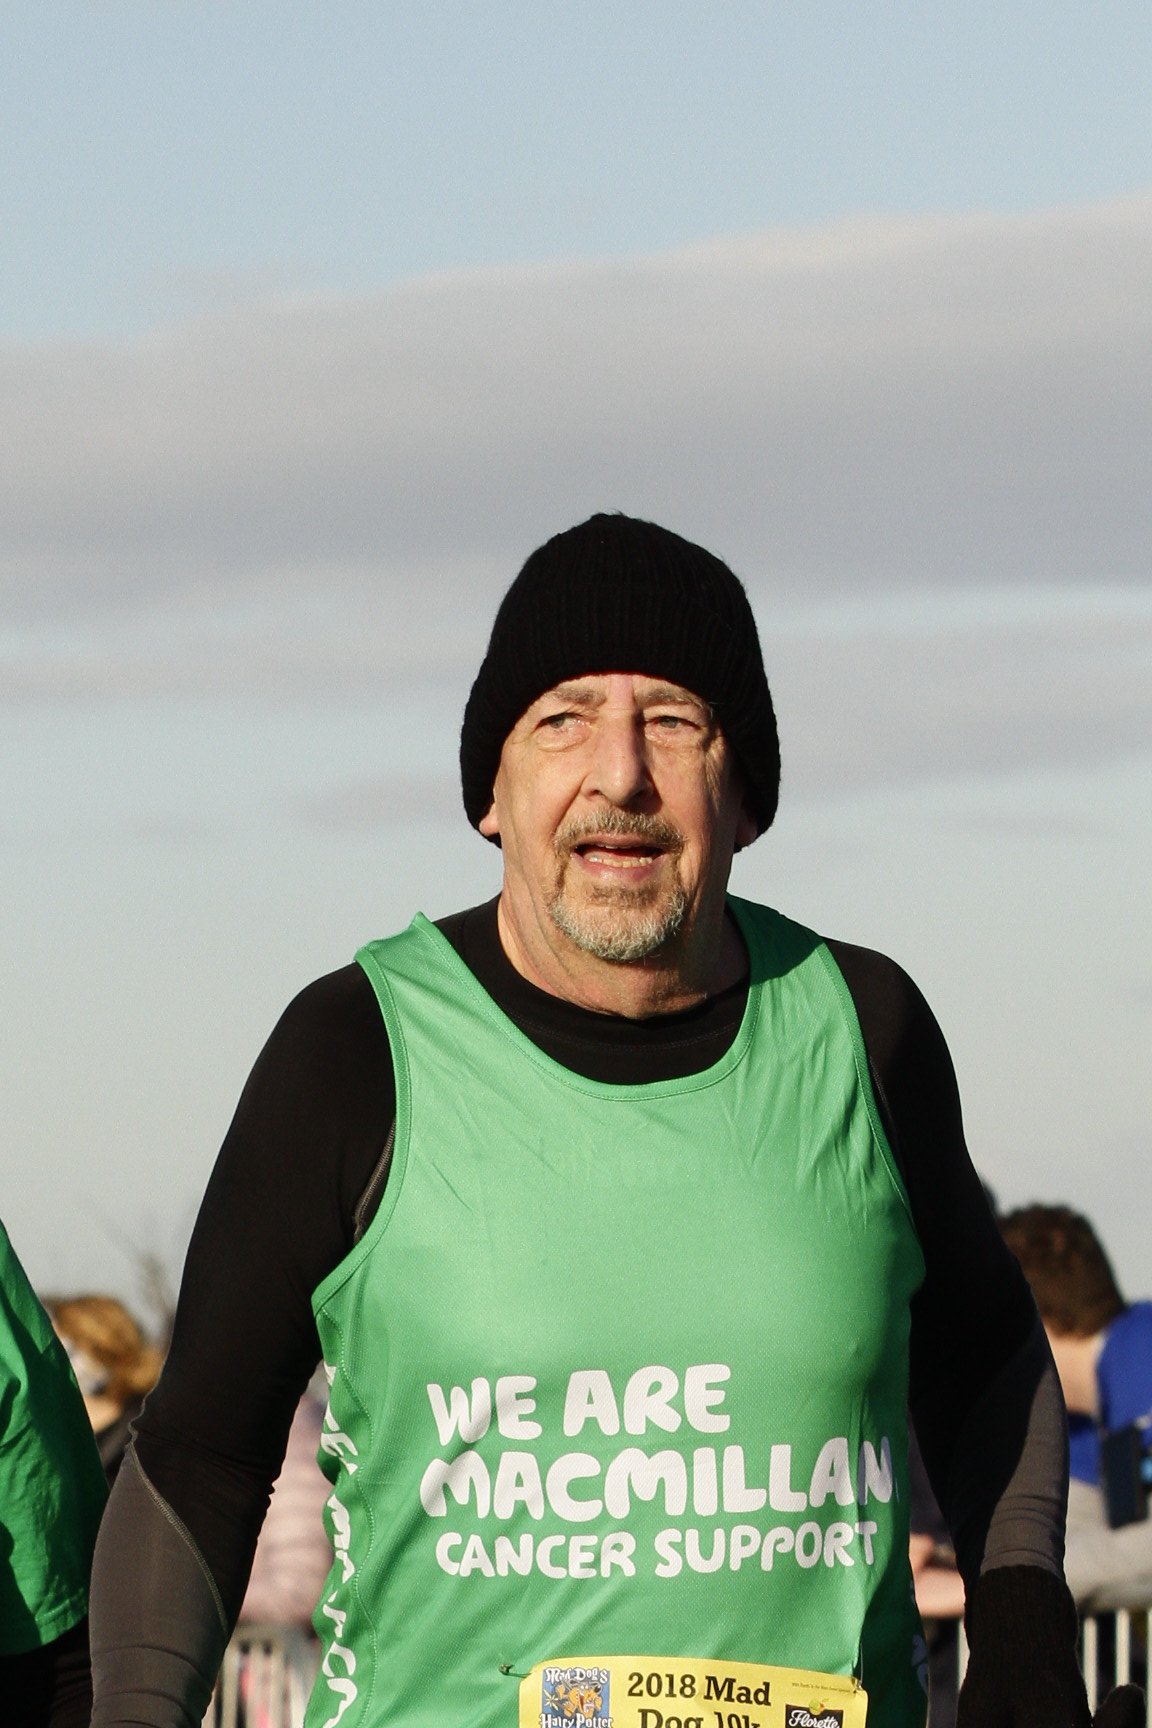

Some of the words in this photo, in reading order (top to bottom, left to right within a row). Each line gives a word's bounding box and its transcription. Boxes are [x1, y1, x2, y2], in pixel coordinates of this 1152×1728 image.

[426, 1376, 543, 1446] WE
[563, 1364, 731, 1437] ARE
[419, 1436, 894, 1522] MACMILLAN
[435, 1531, 636, 1578] CANCER
[654, 1520, 878, 1578] SUPPORT
[628, 1672, 697, 1698] 2018
[704, 1675, 771, 1706] Mad
